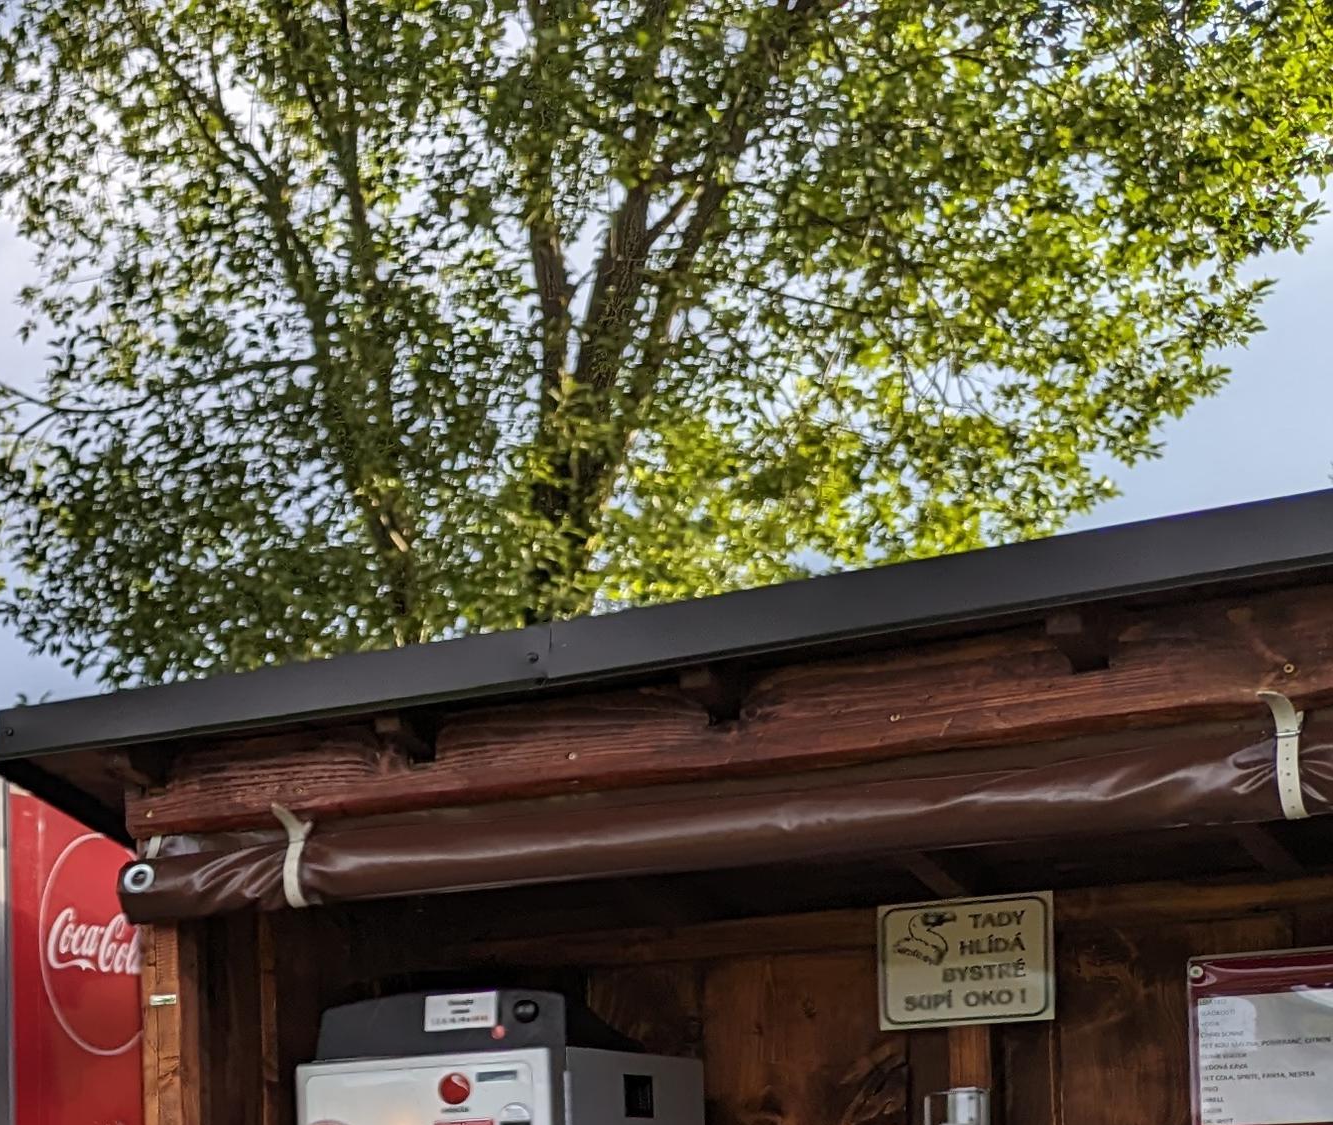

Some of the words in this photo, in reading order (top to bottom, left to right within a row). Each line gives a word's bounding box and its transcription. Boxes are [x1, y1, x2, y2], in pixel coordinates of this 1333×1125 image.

[968, 909, 1025, 929] TADY
[959, 932, 1026, 956] HLÍDÁ
[942, 958, 1027, 983] BYSTRÉ
[904, 989, 953, 1012] SUPÍ
[964, 990, 1013, 1008] OKO
